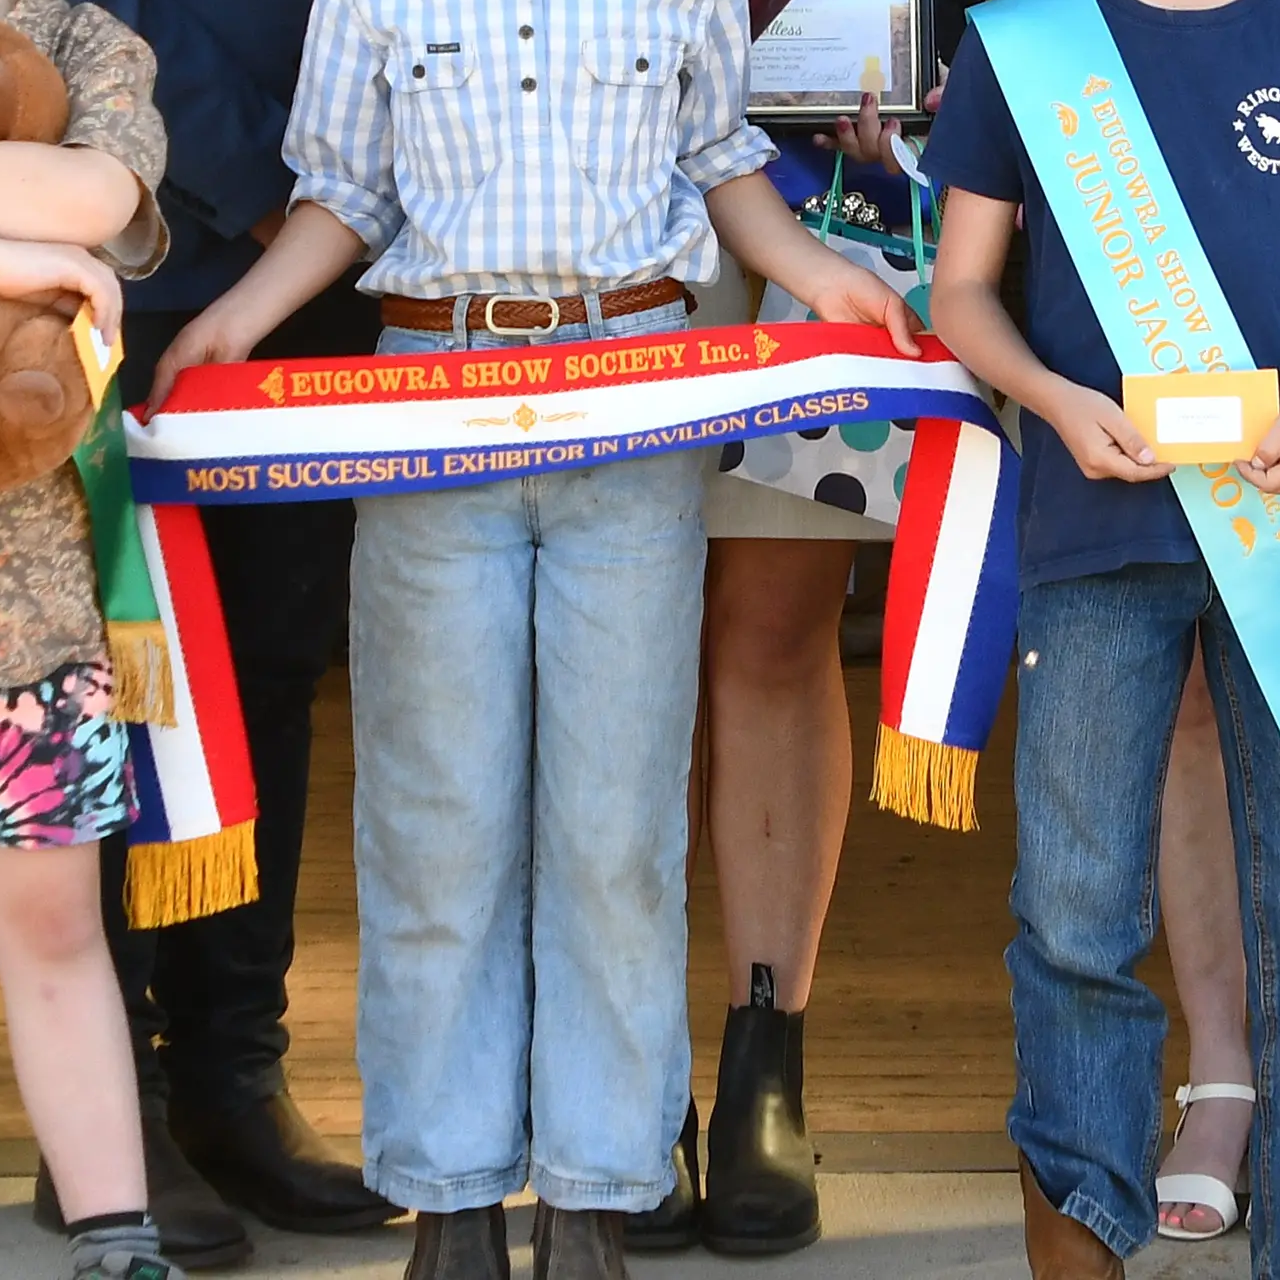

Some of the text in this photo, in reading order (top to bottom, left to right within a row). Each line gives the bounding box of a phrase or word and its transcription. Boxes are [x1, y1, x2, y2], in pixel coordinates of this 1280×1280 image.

[1065, 151, 1146, 290] JUNIOR
[1091, 97, 1168, 246] EUGOWRA
[1155, 249, 1212, 334] SHOW
[290, 339, 750, 397] EUGOWRA SHOW SOCIETY Inc.
[186, 391, 870, 493] MOST SUCCESSFUL EXHIBITOR IN PAVILION CLASSES
